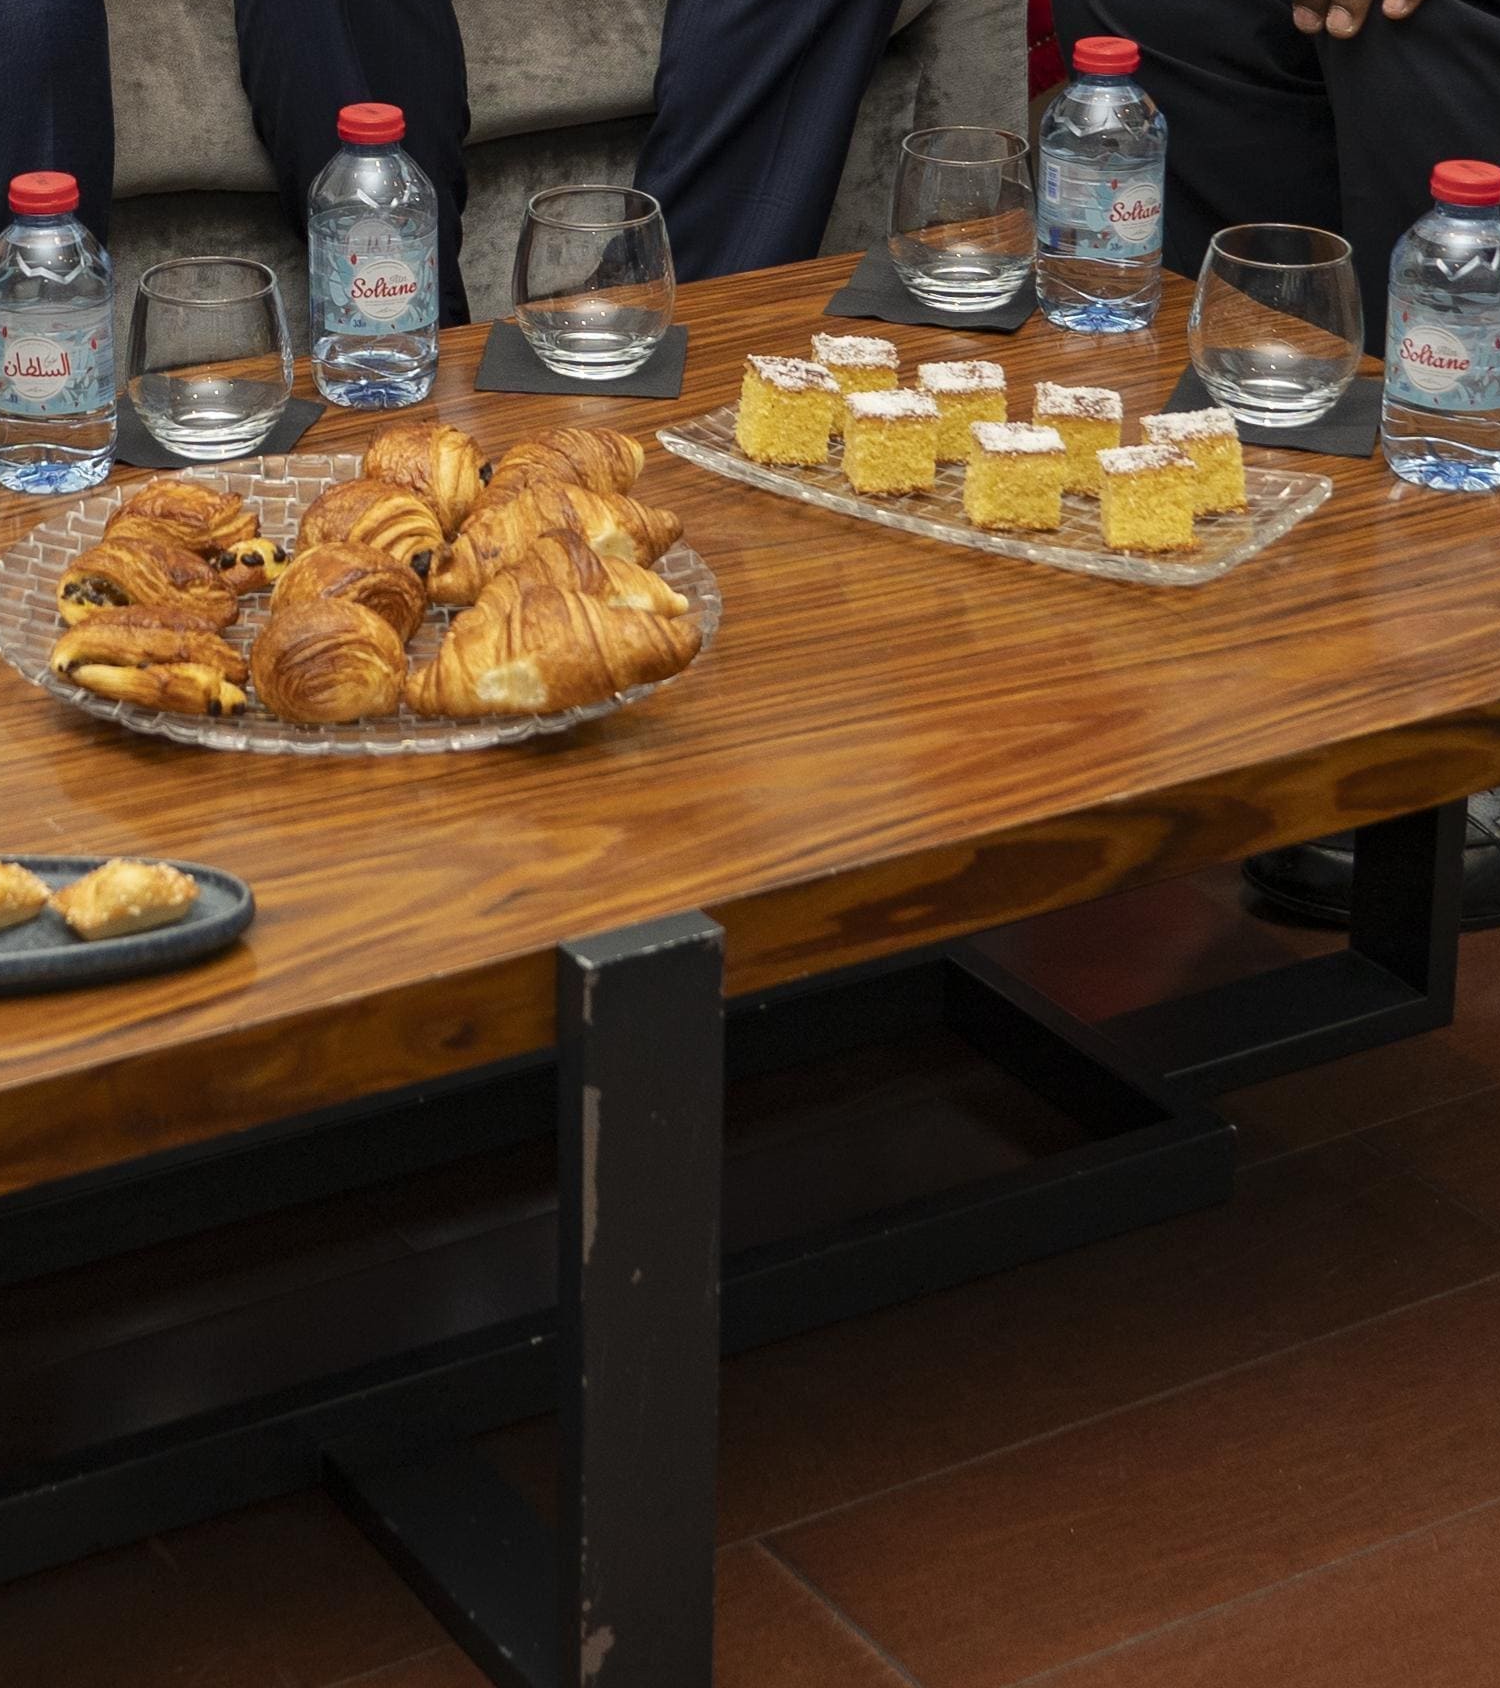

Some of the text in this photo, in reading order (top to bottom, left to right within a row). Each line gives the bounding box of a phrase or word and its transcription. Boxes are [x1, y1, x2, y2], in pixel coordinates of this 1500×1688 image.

[351, 277, 418, 298] Soltane
[4, 352, 71, 377] السلطان
[1400, 338, 1470, 370] Soltane
